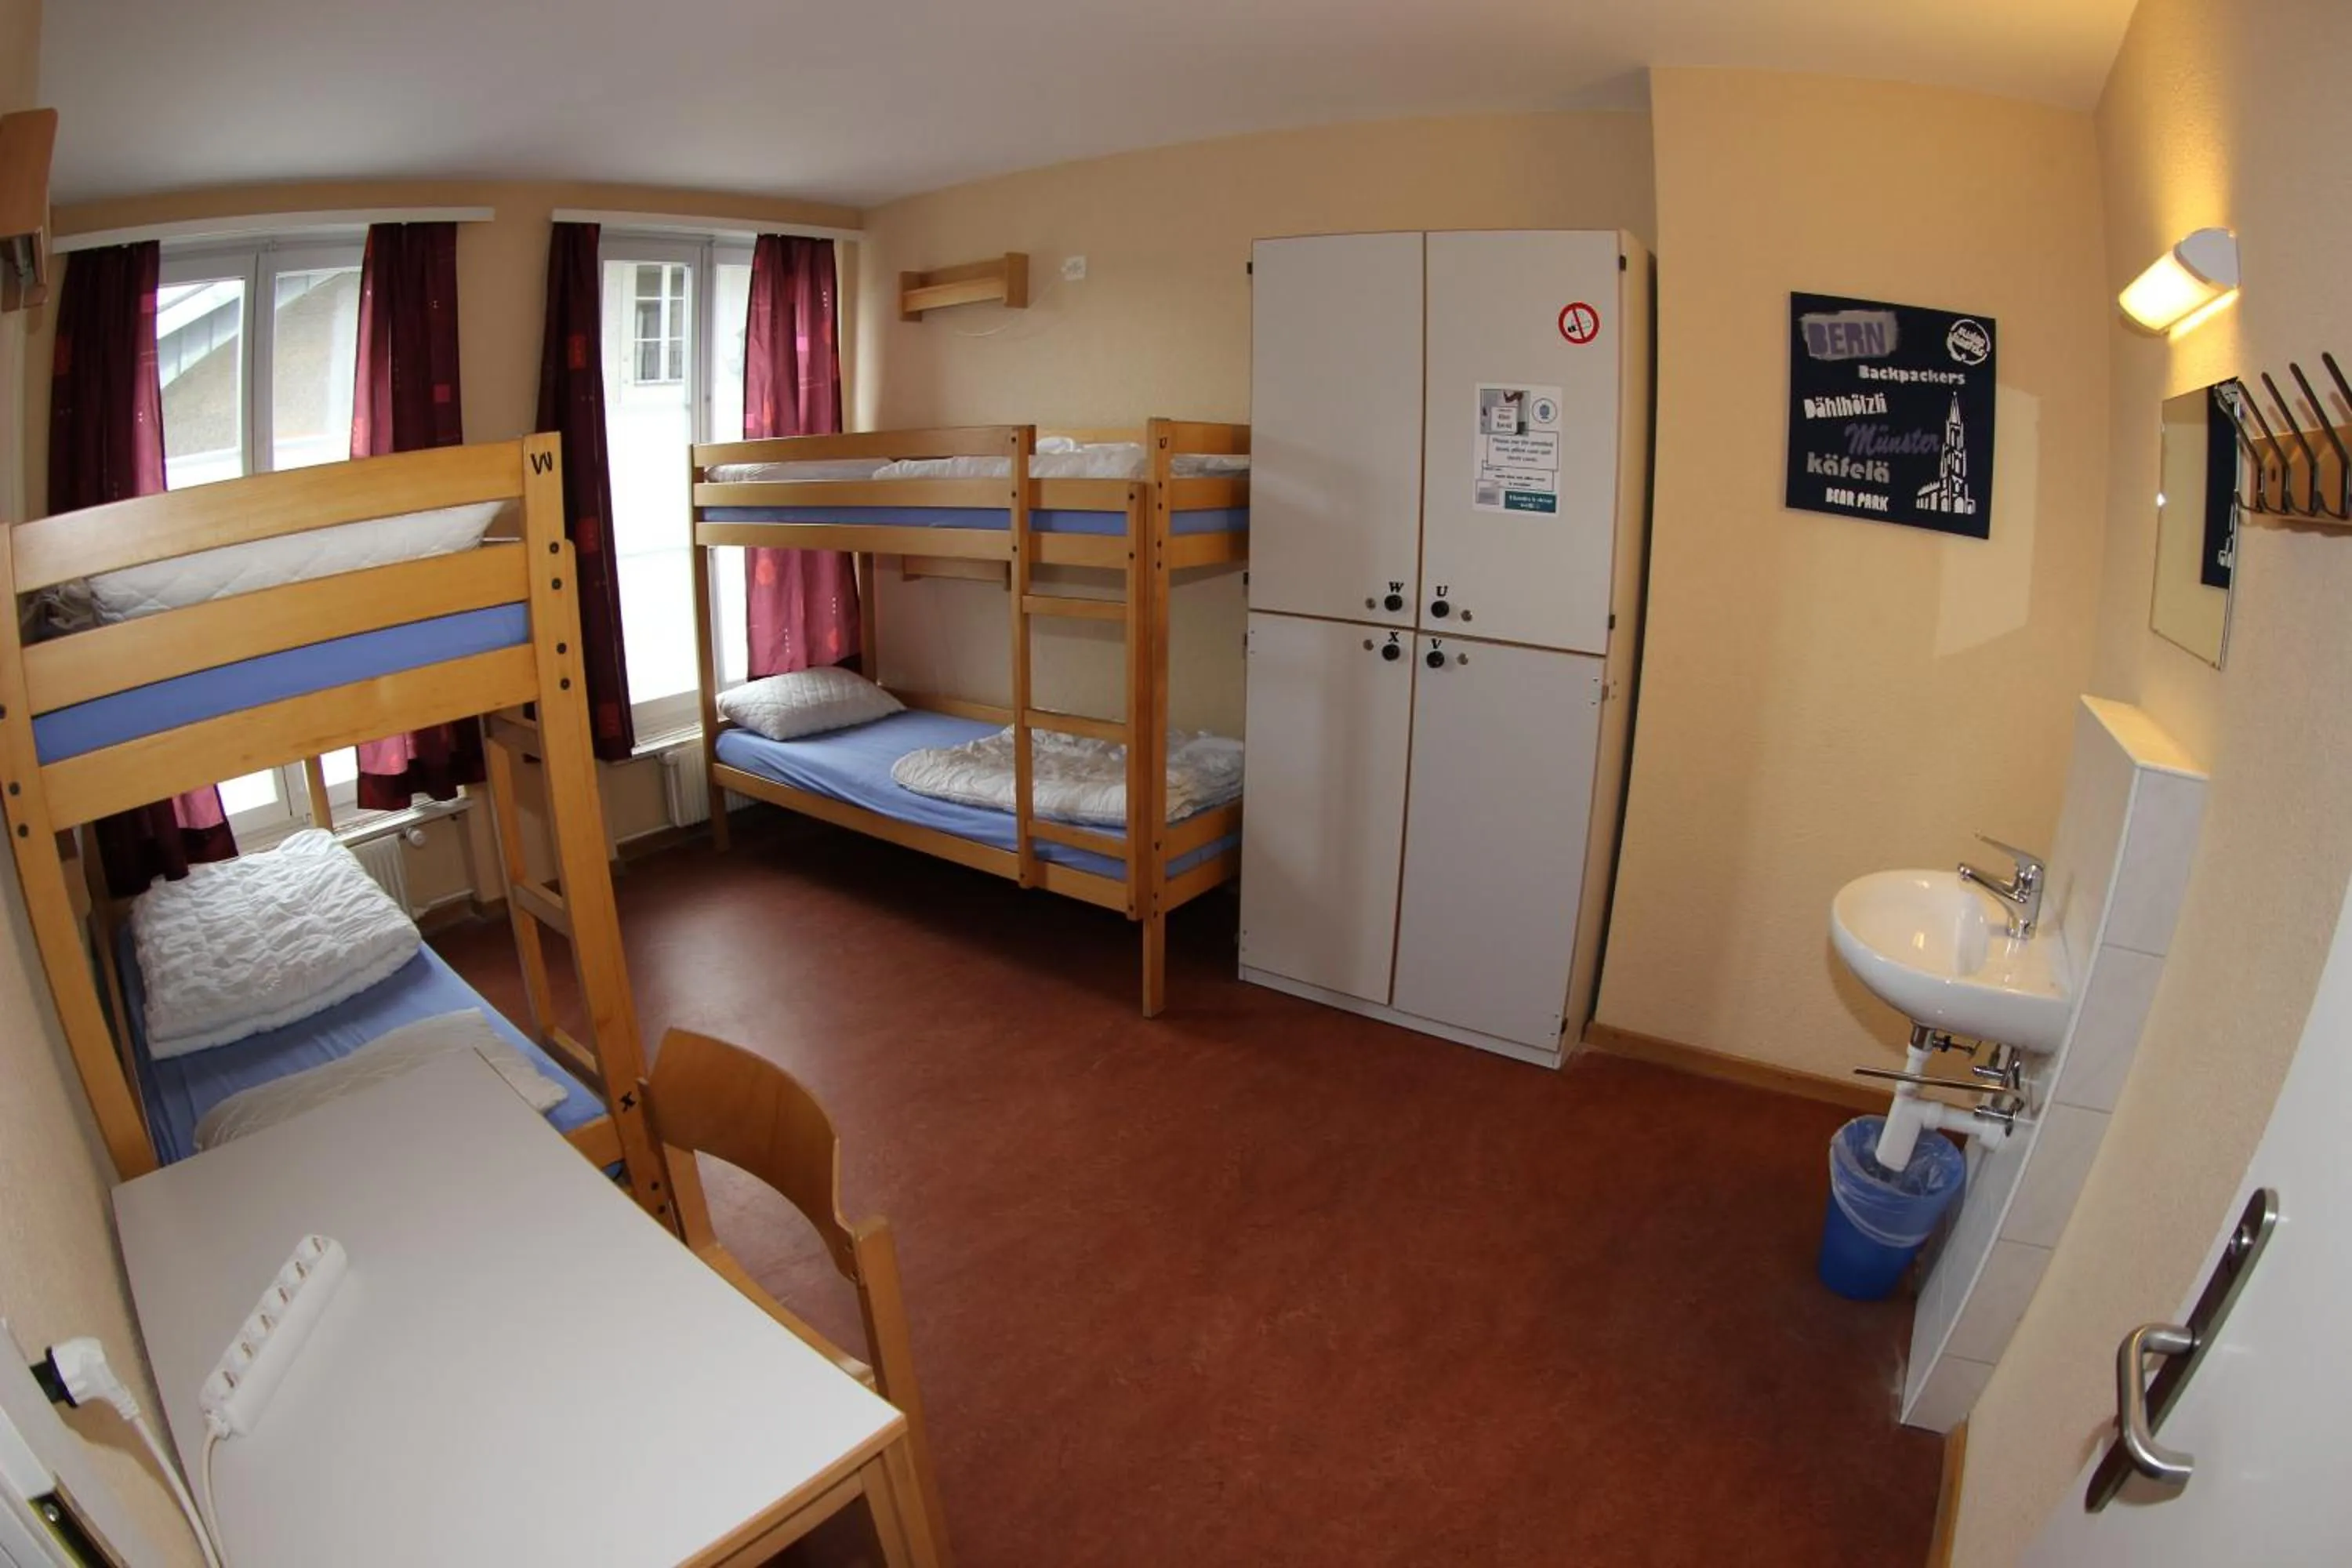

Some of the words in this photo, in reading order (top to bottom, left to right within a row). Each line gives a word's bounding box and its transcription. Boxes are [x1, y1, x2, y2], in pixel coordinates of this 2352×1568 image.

[1806, 322, 1889, 354] BERN
[1857, 365, 1965, 385] Backpackers
[1804, 393, 1888, 419] Dählhölzli
[1844, 423, 1941, 456] Münster
[529, 451, 553, 476] W
[1824, 487, 1855, 507] BEAR
[1857, 492, 1889, 512] PARK
[1388, 581, 1404, 593] W
[1436, 585, 1448, 597] U
[1388, 631, 1399, 642] X
[1431, 637, 1442, 650] V
